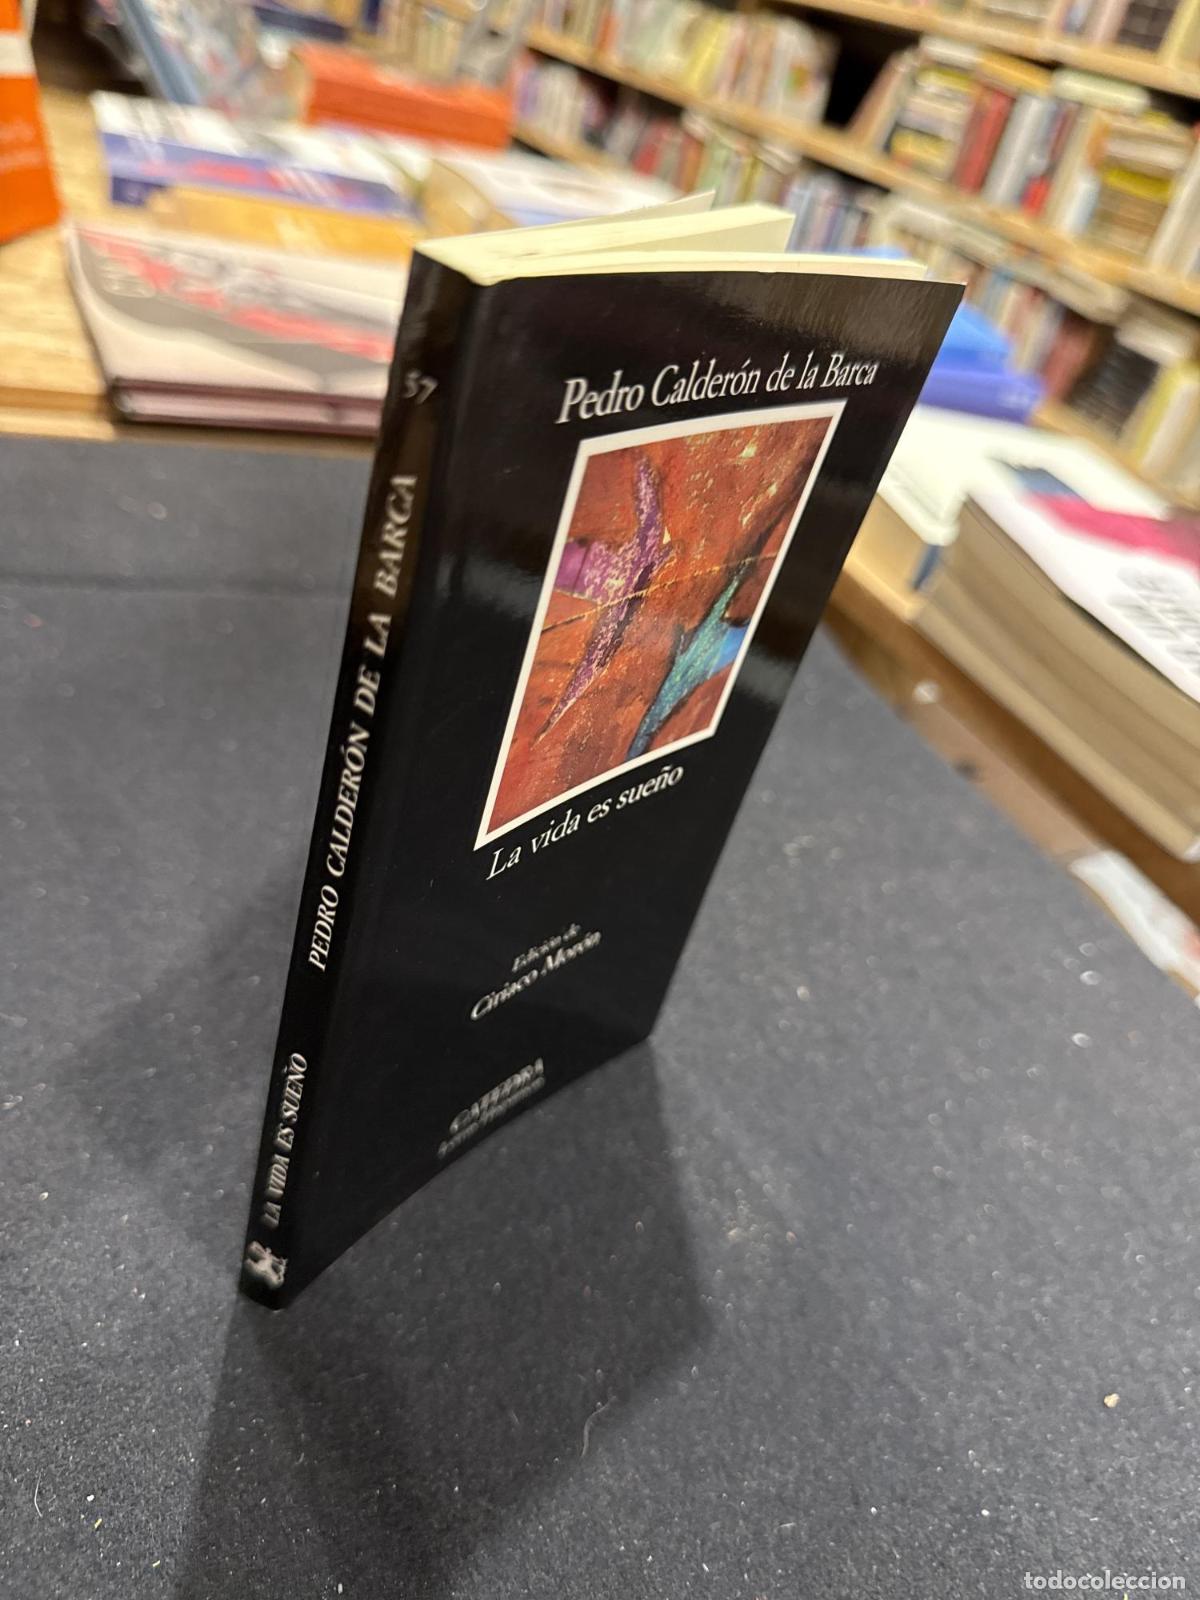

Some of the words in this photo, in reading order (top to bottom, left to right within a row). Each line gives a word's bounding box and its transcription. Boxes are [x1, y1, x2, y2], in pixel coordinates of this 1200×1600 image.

[554, 370, 645, 424] Pedro
[651, 358, 761, 407] Calderón
[765, 351, 793, 392] de
[796, 350, 820, 389] la
[820, 351, 880, 388] Barca
[374, 474, 418, 599] BARCA
[363, 611, 393, 659] LA
[353, 664, 381, 718] DE
[326, 720, 372, 879] CALDERÓN
[486, 846, 522, 880] La
[531, 808, 581, 854] vida
[587, 798, 612, 824] es
[616, 764, 684, 810] sueño
[308, 884, 340, 973] PEDRO
[265, 1153, 291, 1199] VIDA
[281, 1052, 308, 1125] SUEÑO
